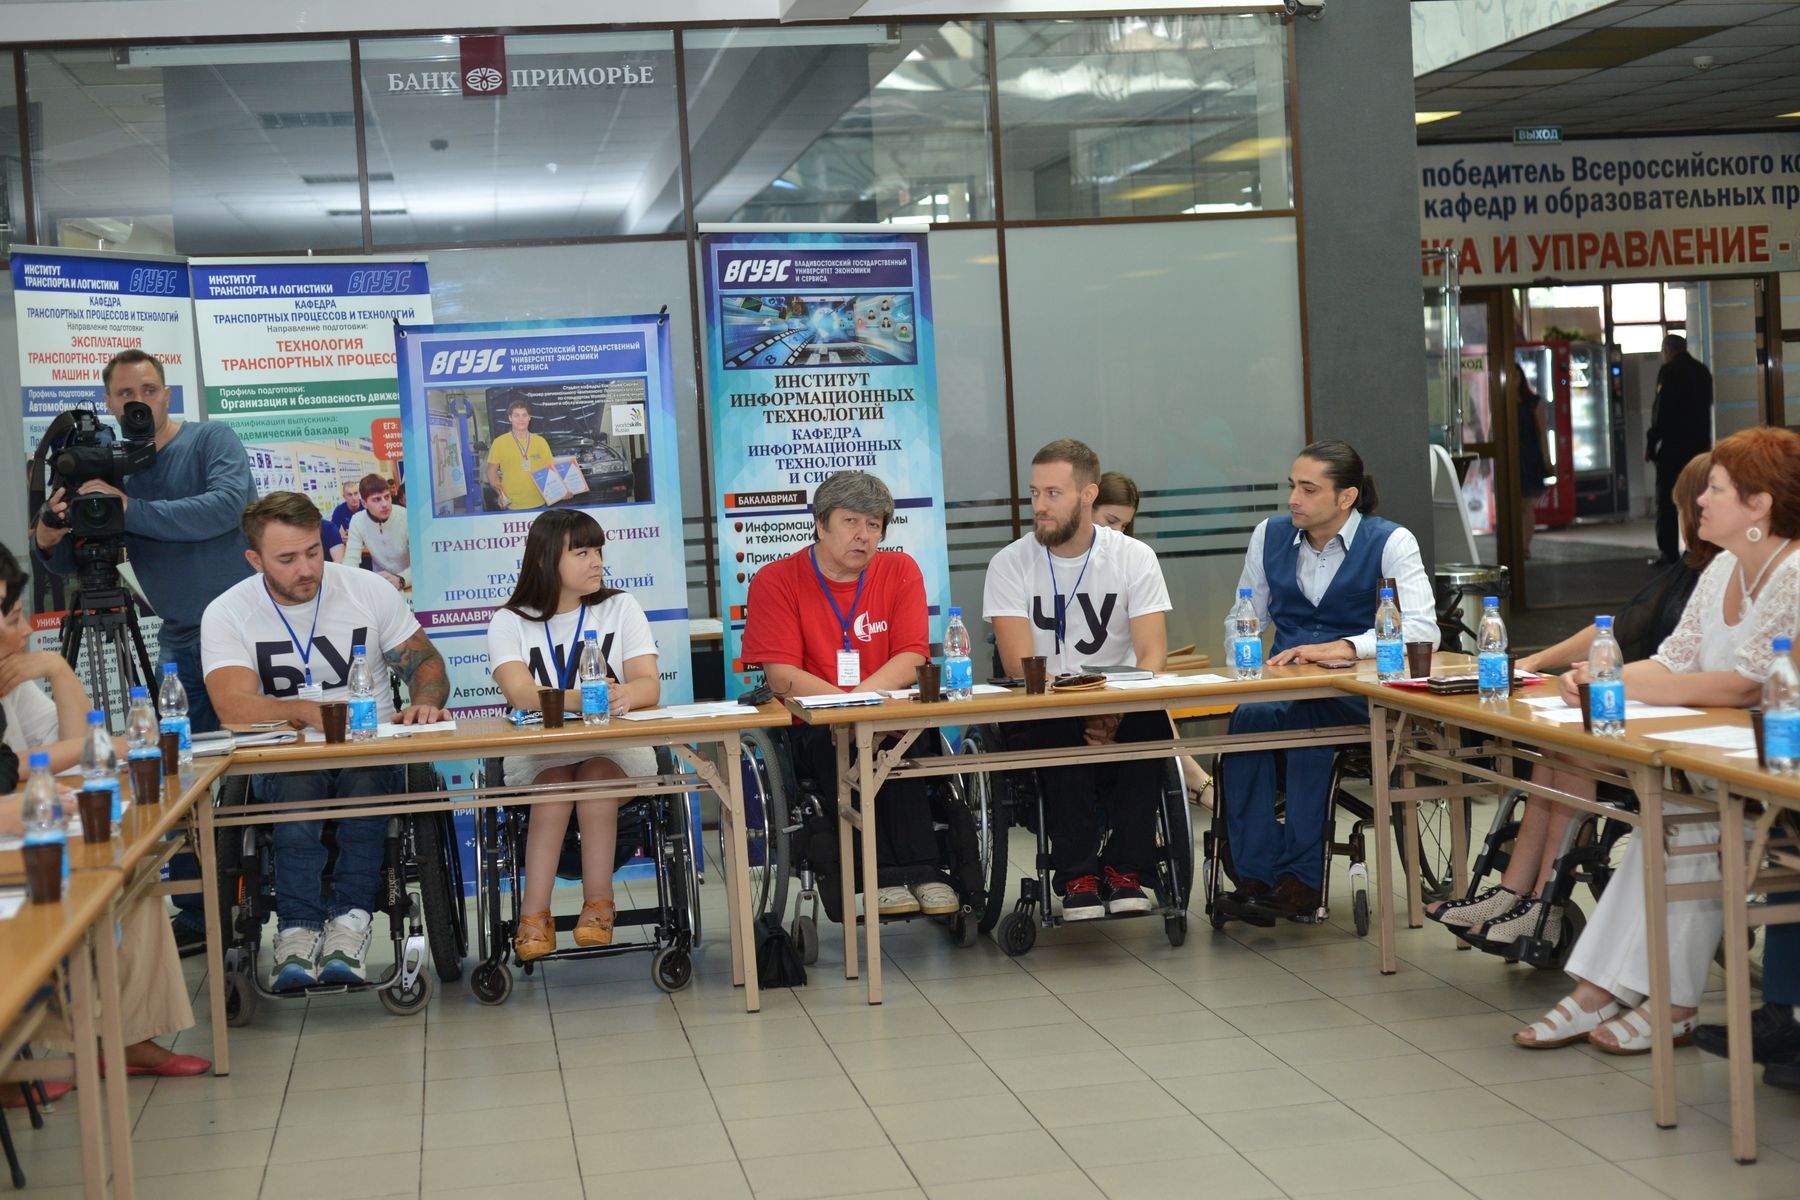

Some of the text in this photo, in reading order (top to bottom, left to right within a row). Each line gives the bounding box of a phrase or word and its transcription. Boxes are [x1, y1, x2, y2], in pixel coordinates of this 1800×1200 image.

[388, 65, 655, 91] БАНК ПРИМОРЬЕ
[1519, 129, 1558, 140] ВЫХОД
[1423, 158, 1565, 188] победитель
[1572, 151, 1774, 185] Всероссийского
[1424, 192, 1516, 222] кафедр
[1525, 195, 1537, 213] и
[1546, 184, 1765, 218] образовательных
[1493, 235, 1518, 273] И
[1528, 225, 1770, 271] УПРАВЛЕНИЕ
[795, 257, 907, 268] ВЛАДИВОСТОКСКИЙ ГОСУДАРСТВЕННЫЙ
[24, 264, 61, 276] ИНСТИТУТ
[724, 259, 792, 283] ВГУЭС
[795, 268, 833, 276] УНИВЕРСИТЕТ
[24, 276, 70, 288] ТРАНСПОРТА
[77, 279, 119, 291] ЛОГИСТИКИ
[129, 268, 177, 294] ВГУЭС
[208, 275, 256, 285] ИНСТИТУТ
[347, 270, 411, 293] ВГУЭС
[209, 284, 333, 296] ТРАНСПОРТА И ЛОГИСТИКИ
[89, 296, 121, 307] КАФЕДРА
[295, 300, 336, 310] КАФЕДРА
[27, 307, 179, 322] ТРАНСПОРТНЫХ ПРОЦЕССОВ И ТЕХНОЛОГИЙ
[213, 308, 415, 324] ТРАНСПОРТНЫХ ПРОЦЕССОВ И ТЕХНОЛОГИЙ
[67, 323, 108, 332] Направление
[267, 322, 368, 333] Направление подготовки:
[71, 336, 142, 348] ЭКСПЛУАТАЦИЯ
[276, 338, 364, 352] ТЕХНОЛОГИЯ
[510, 341, 640, 356] ВЛАДИВОСТОКСКИЙ ГОСУДАРСТВЕННЫЙ
[221, 352, 397, 371] ТРАНСПОРТНЫХ ПРОЦЕСС
[430, 348, 507, 375] ВГУЭС
[510, 353, 599, 364] УНИВЕРСИТЕТ ЭКОНОМИКИ
[519, 363, 549, 371] СЕРВИСА
[52, 369, 89, 380] МАШИН
[775, 372, 870, 389] ИНСТИТУТ
[220, 385, 305, 398] Профиль подготовки:
[730, 388, 915, 408] ИНФОРМАЦИОННЫХ
[221, 397, 288, 411] Организация
[290, 397, 296, 405] и
[298, 393, 366, 406] безопасность
[763, 402, 885, 424] ТЕХНОЛОГИЙ
[304, 426, 349, 436] бакалавр
[792, 427, 862, 441] КАФЕДРА
[748, 439, 902, 457] ИНФОРМАЦИОННЫХ
[775, 452, 876, 470] ТЕХНОЛОГИЙ
[789, 472, 800, 484] И
[738, 493, 797, 505] БАКАЛАВРИАТ
[745, 520, 815, 534] Информаци
[756, 532, 815, 545] технологи
[445, 587, 513, 601] ПРОЦЕСС
[432, 610, 495, 625] БАКАЛАВРИ
[1033, 593, 1117, 655] ЧУ
[256, 627, 367, 697] БУ
[453, 686, 504, 698] Автомо
